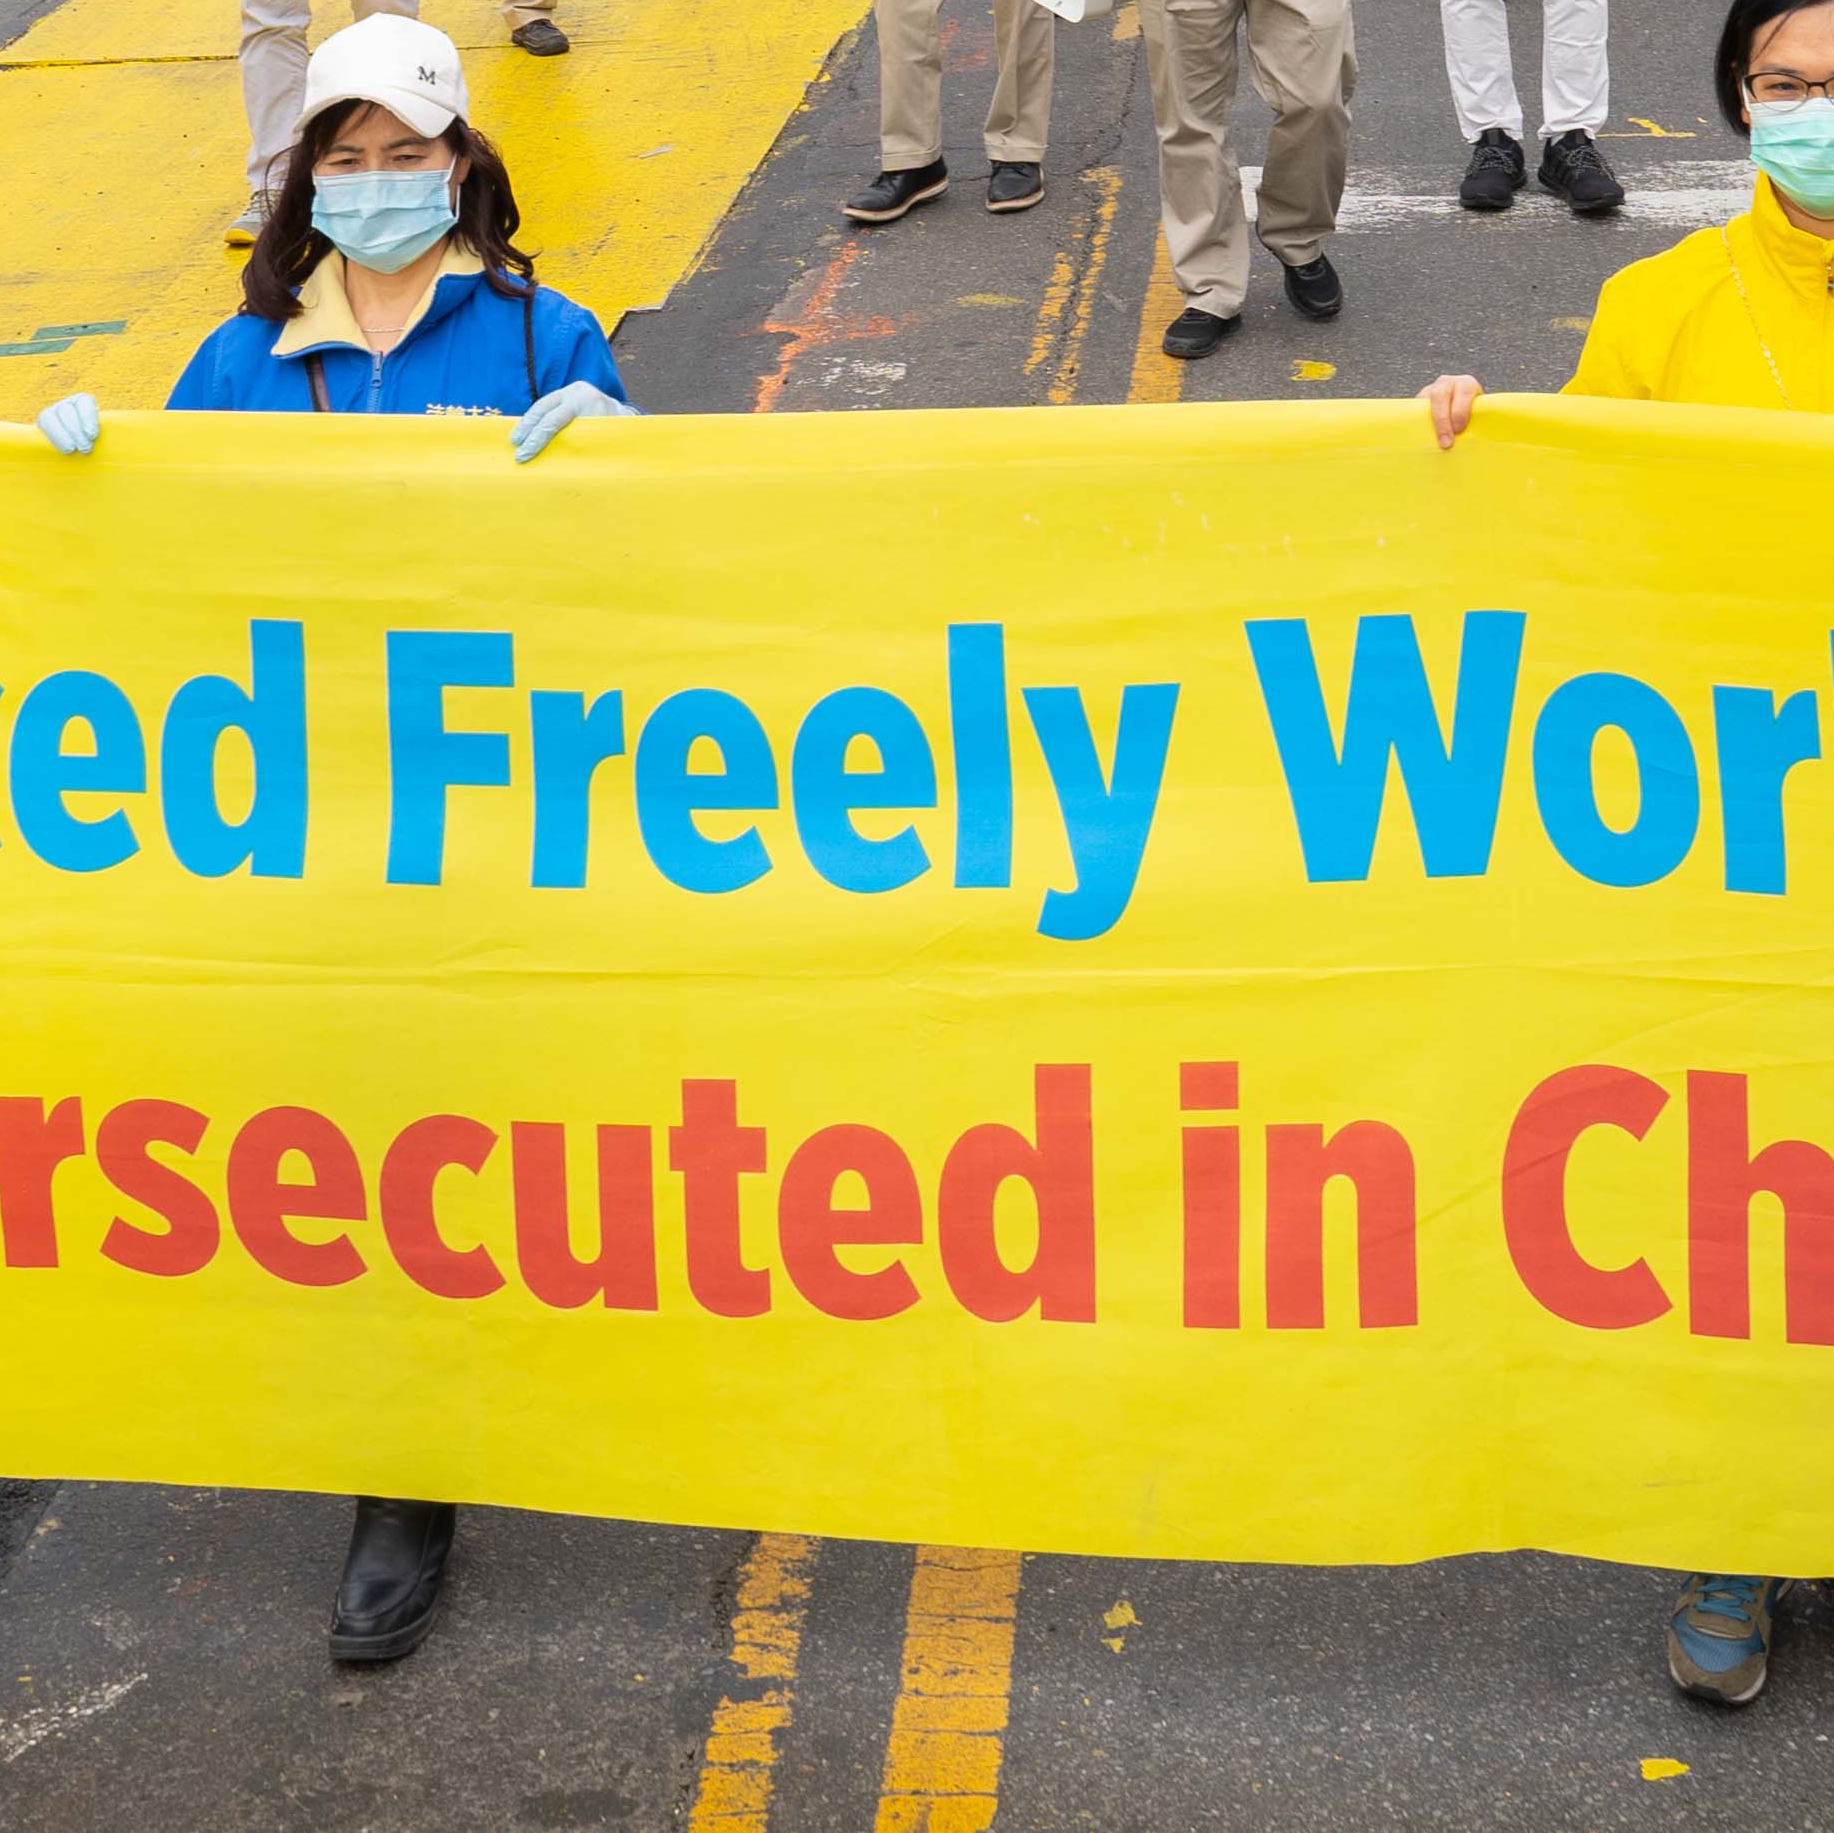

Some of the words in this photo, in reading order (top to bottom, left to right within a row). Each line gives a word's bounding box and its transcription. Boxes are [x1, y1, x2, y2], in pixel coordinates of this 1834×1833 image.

[417, 66, 437, 86] M
[387, 624, 1179, 939] Freely
[1184, 1062, 1417, 1328] in
